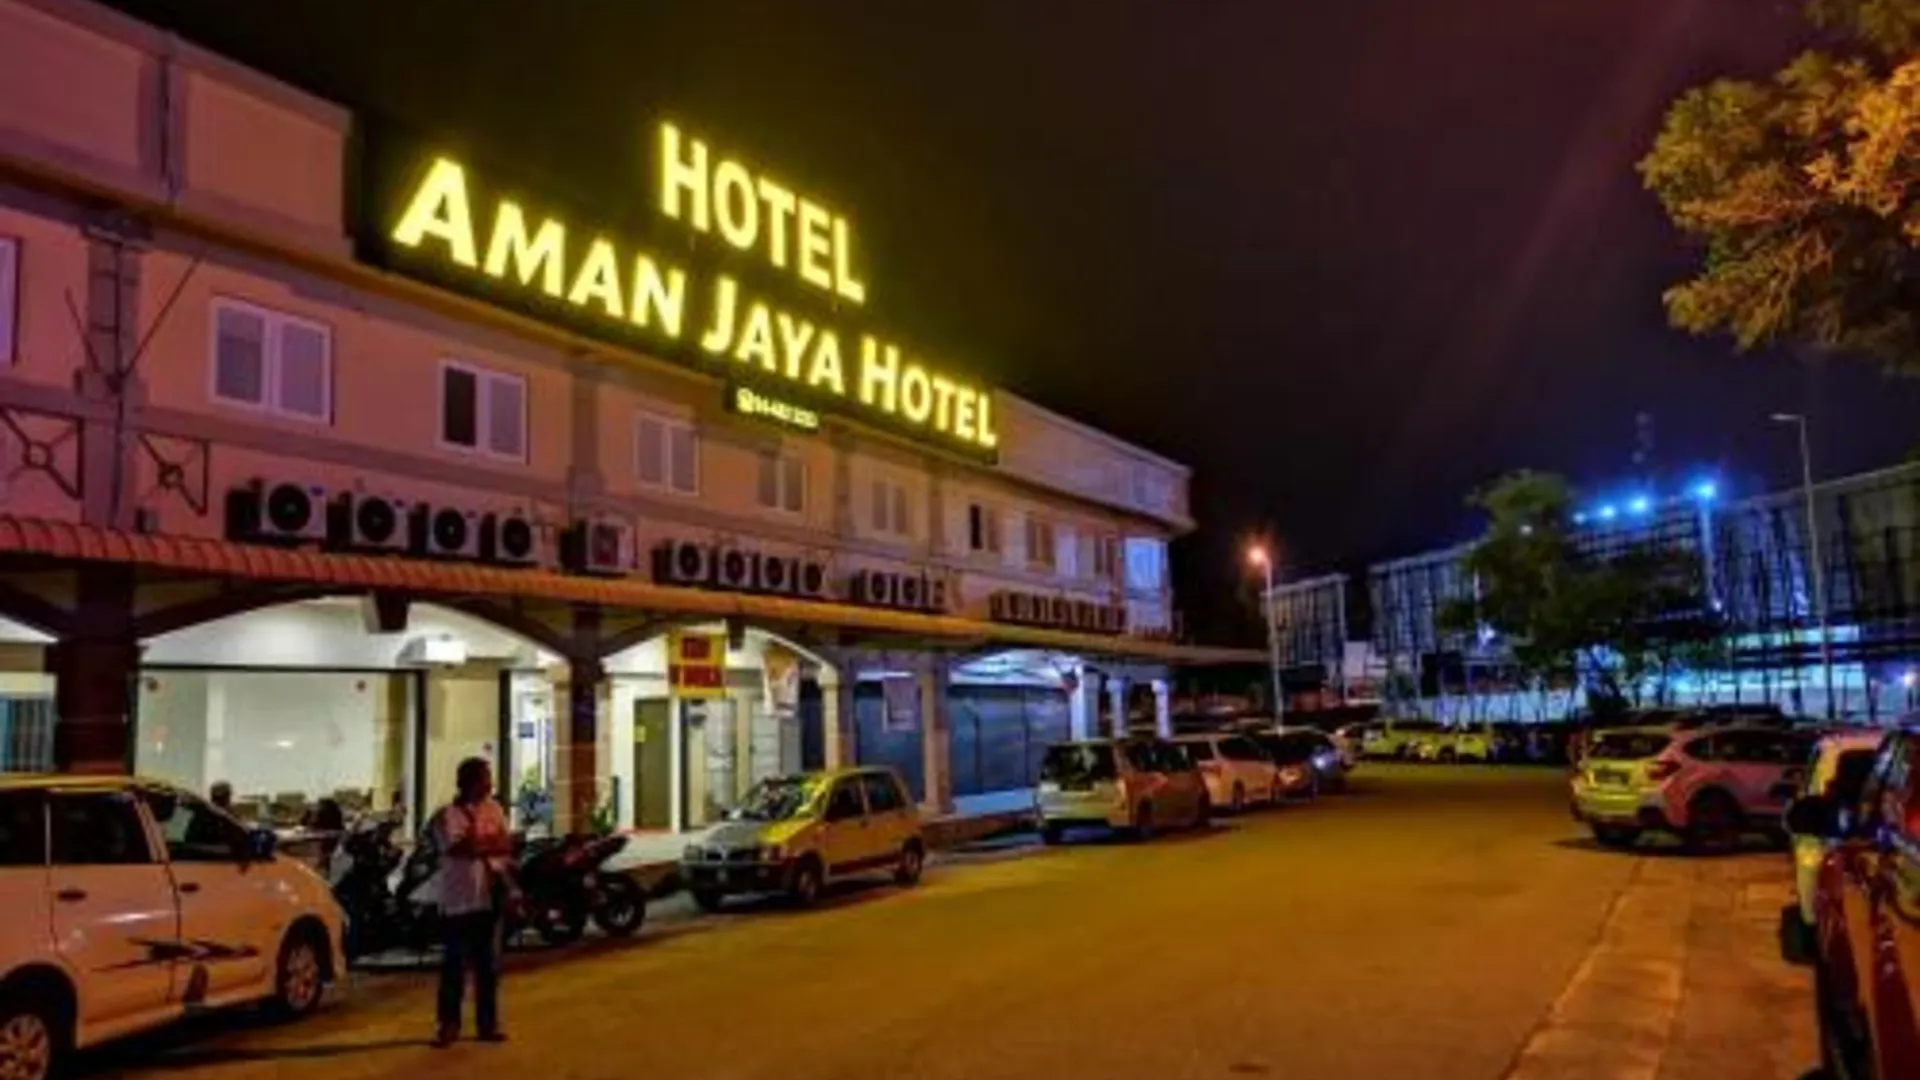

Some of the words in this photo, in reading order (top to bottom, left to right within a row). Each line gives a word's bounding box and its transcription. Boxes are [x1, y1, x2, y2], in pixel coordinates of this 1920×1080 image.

[392, 157, 686, 339] AMAN
[701, 276, 846, 395] JAYA
[860, 335, 999, 448] HOTEL
[660, 122, 866, 304] HOTEL
